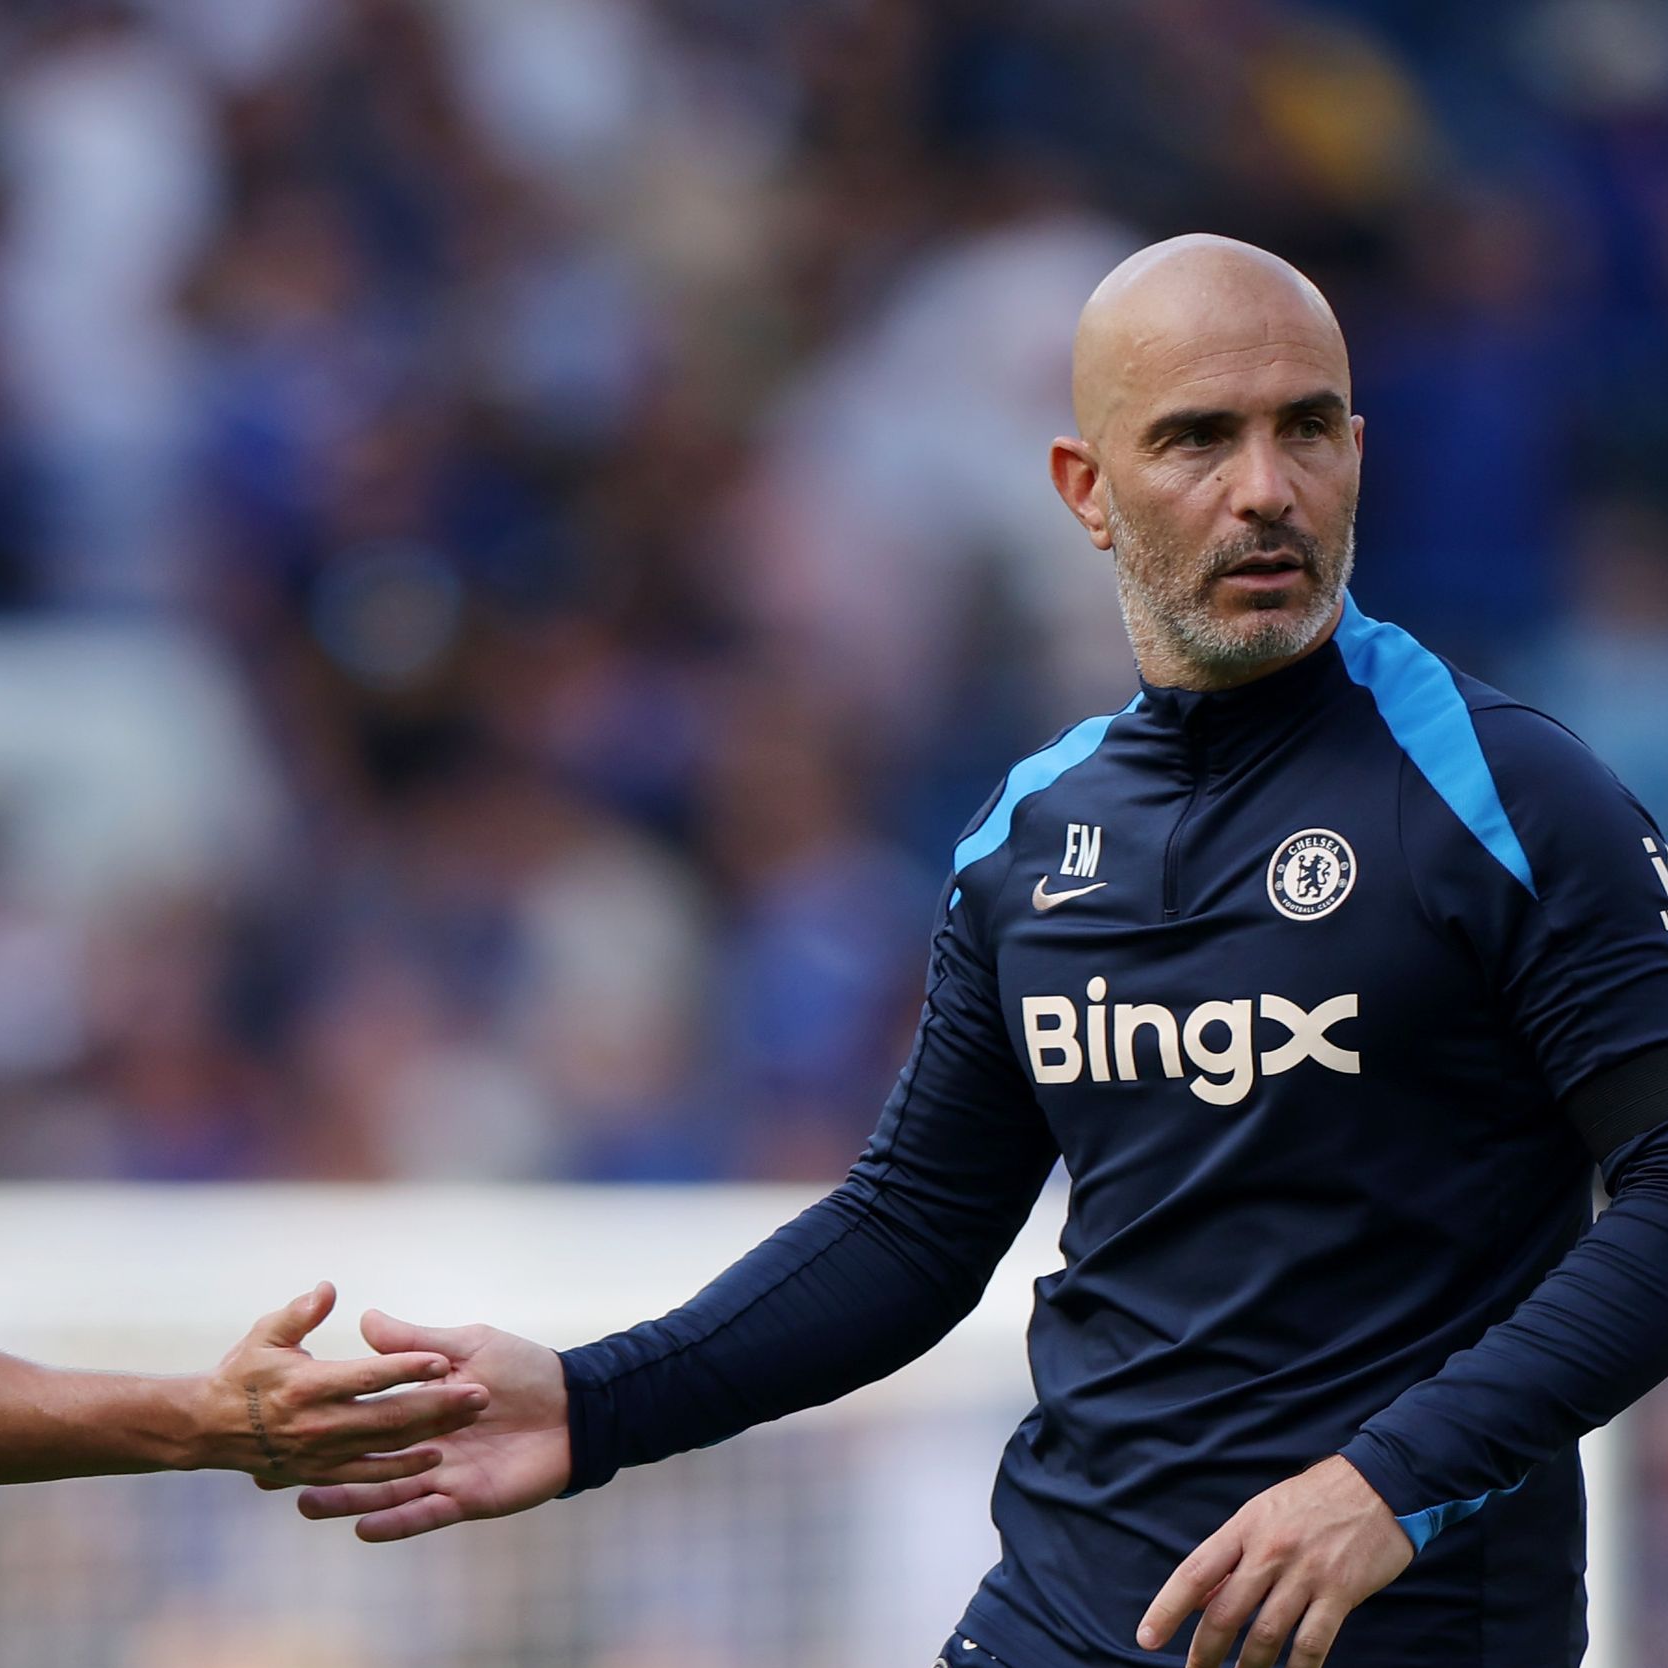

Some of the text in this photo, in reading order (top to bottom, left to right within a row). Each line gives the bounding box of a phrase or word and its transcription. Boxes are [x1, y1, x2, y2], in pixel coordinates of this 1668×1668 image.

[1059, 823, 1102, 878] EM
[1287, 837, 1340, 855] CHELSEA
[1282, 896, 1336, 914] FOOTBALL CLUB
